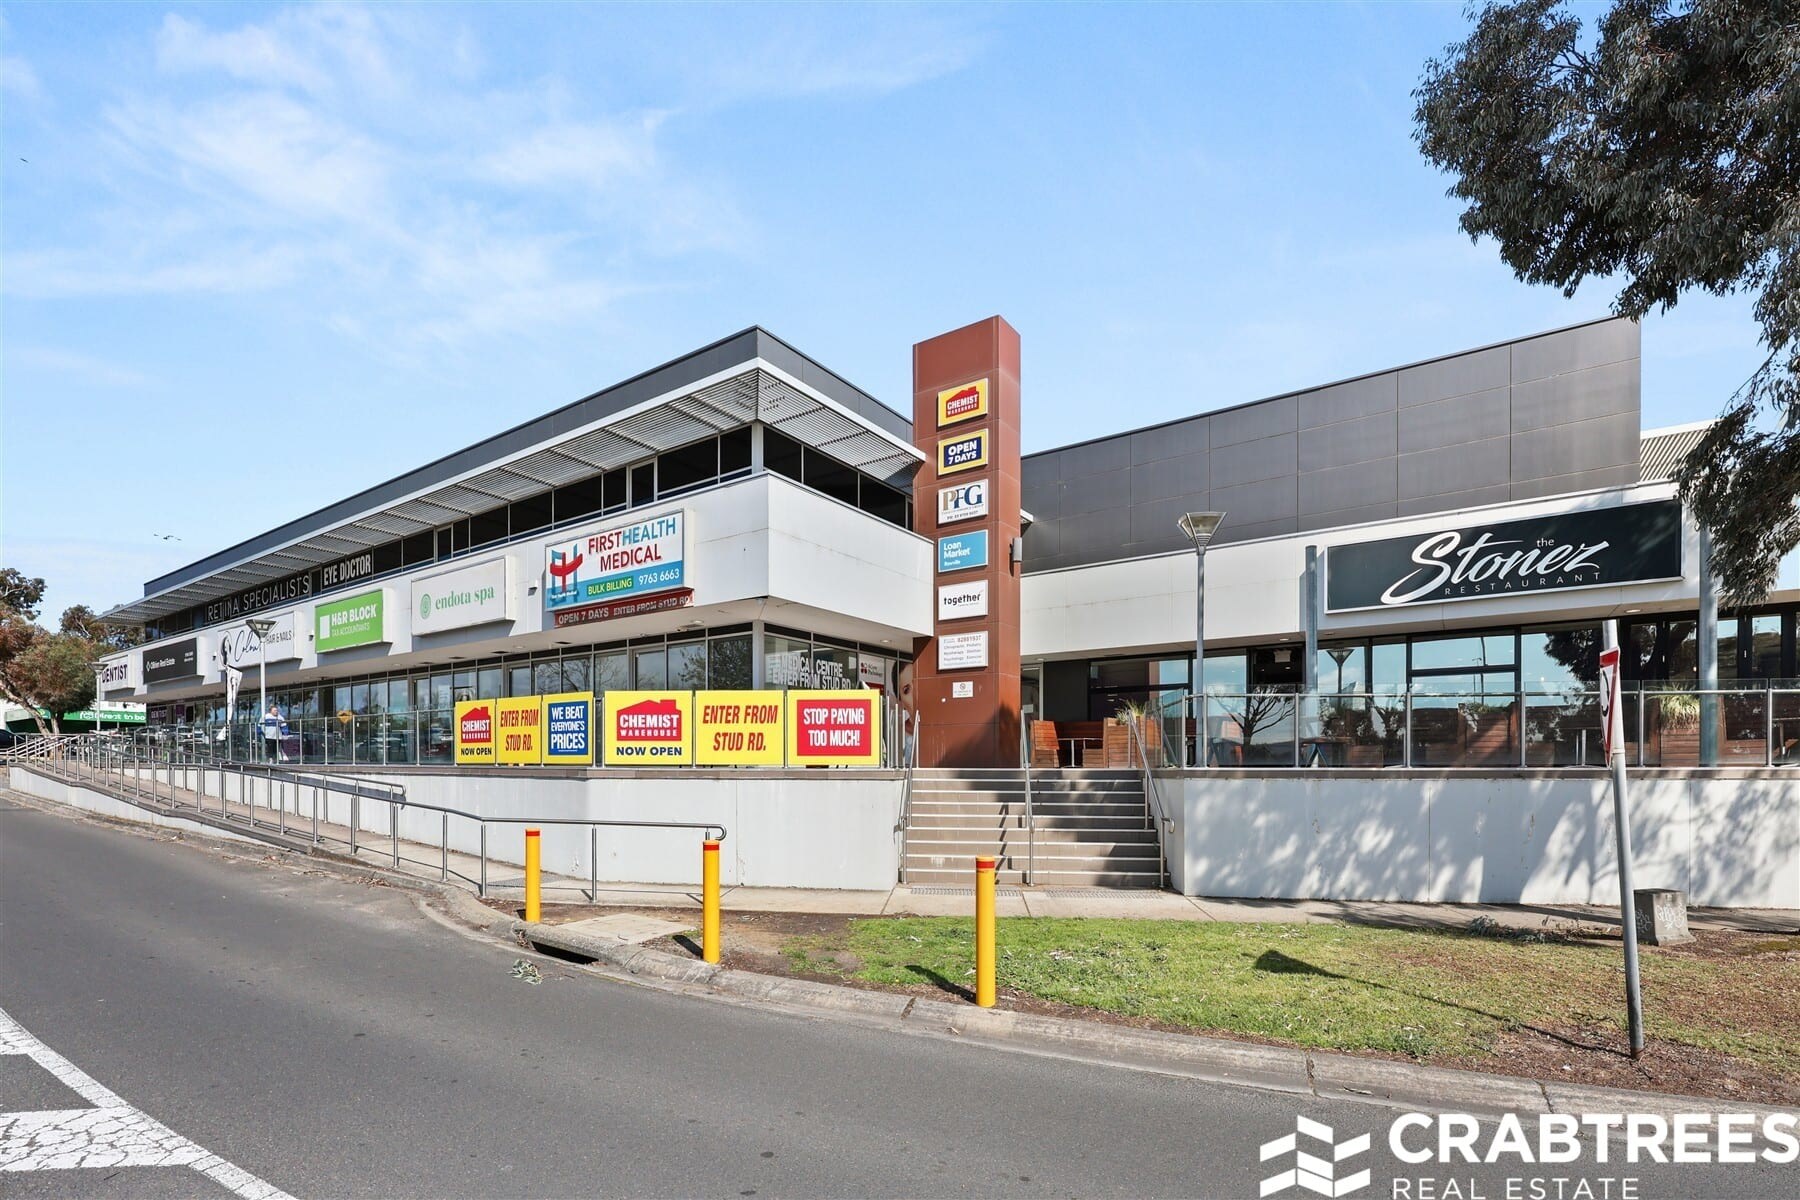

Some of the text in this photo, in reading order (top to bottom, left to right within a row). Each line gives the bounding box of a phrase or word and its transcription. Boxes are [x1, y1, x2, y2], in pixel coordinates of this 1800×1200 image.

[947, 394, 978, 410] CHEMIST
[947, 403, 977, 416] WAREHOUSE
[948, 440, 977, 456] OPEN
[954, 450, 977, 463] DAYS
[943, 484, 983, 511] PFG
[588, 517, 676, 555] FIRSTHEALTH
[1536, 537, 1555, 548] the
[943, 542, 962, 550] Loan
[943, 547, 970, 559] Market
[600, 543, 662, 573] MEDICAL
[323, 553, 371, 586] EYE DOCTOR
[1380, 531, 1609, 605] Stonez
[638, 568, 680, 586] 9763 6663
[1444, 571, 1601, 596] RESTAURANT
[588, 584, 604, 595] BULK
[606, 578, 633, 592] BILLING
[208, 575, 310, 621] RETINA SPECIALISTS
[435, 586, 495, 610] endota spa
[943, 593, 981, 606] together
[331, 603, 377, 626] H&R BLOCK
[558, 613, 580, 625] OPEN
[581, 612, 586, 621] 7
[588, 608, 609, 620] DAYS
[613, 605, 635, 616] ENTER
[636, 601, 657, 612] FROM
[658, 597, 677, 609] STUD
[102, 664, 128, 683] DENTIST
[816, 659, 843, 677] CENTRE
[772, 670, 798, 687] ENTER
[800, 672, 821, 689] FROM
[822, 675, 841, 690] STUD
[500, 708, 539, 728] ENTER FROM
[551, 705, 585, 720] WE BEAT
[702, 705, 778, 724] ENTER FROM
[803, 707, 865, 725] STOP PAYING
[461, 719, 490, 733] CHEMIST
[551, 720, 585, 732] EVERYONE'S
[619, 714, 679, 729] CHEMIST
[462, 732, 489, 740] WAREHOUSE
[551, 733, 585, 750] PRICES
[620, 729, 678, 737] WAREHOUSE
[713, 732, 766, 751] STUD RD.
[807, 729, 860, 747] TOO MUCH!
[505, 734, 533, 751] STUD RD.
[616, 746, 682, 756] NOW OPEN
[460, 747, 492, 756] NOW OPEN
